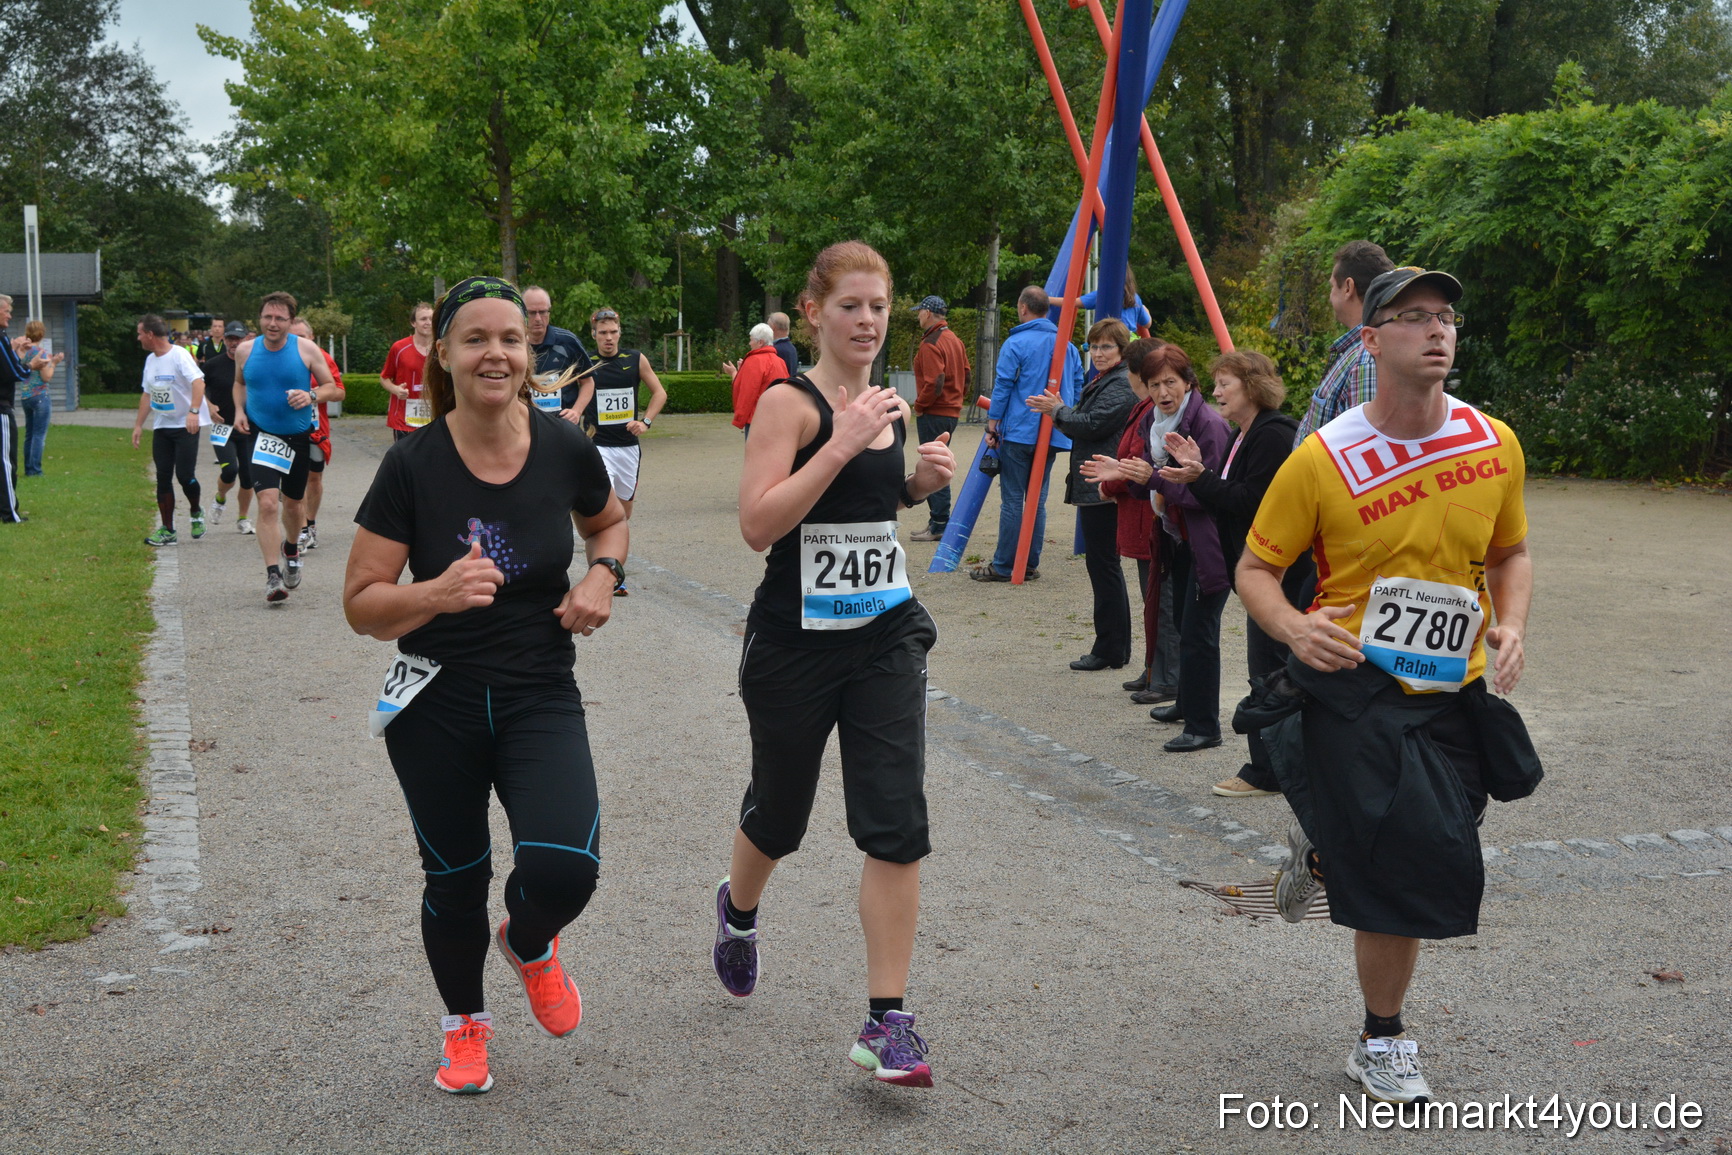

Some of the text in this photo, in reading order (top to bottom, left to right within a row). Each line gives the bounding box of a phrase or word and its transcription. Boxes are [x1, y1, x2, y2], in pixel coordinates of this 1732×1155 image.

[605, 396, 628, 411] 218
[259, 438, 293, 459] 3320
[1358, 457, 1508, 526] MAX BÖGL
[803, 534, 842, 545] PARTL
[814, 546, 898, 589] 2461
[833, 597, 886, 615] Daniela
[1374, 586, 1468, 608] PARTL Neumarkt
[1373, 602, 1470, 652] 2780
[1393, 656, 1437, 678] Ralph
[384, 660, 430, 699] 07
